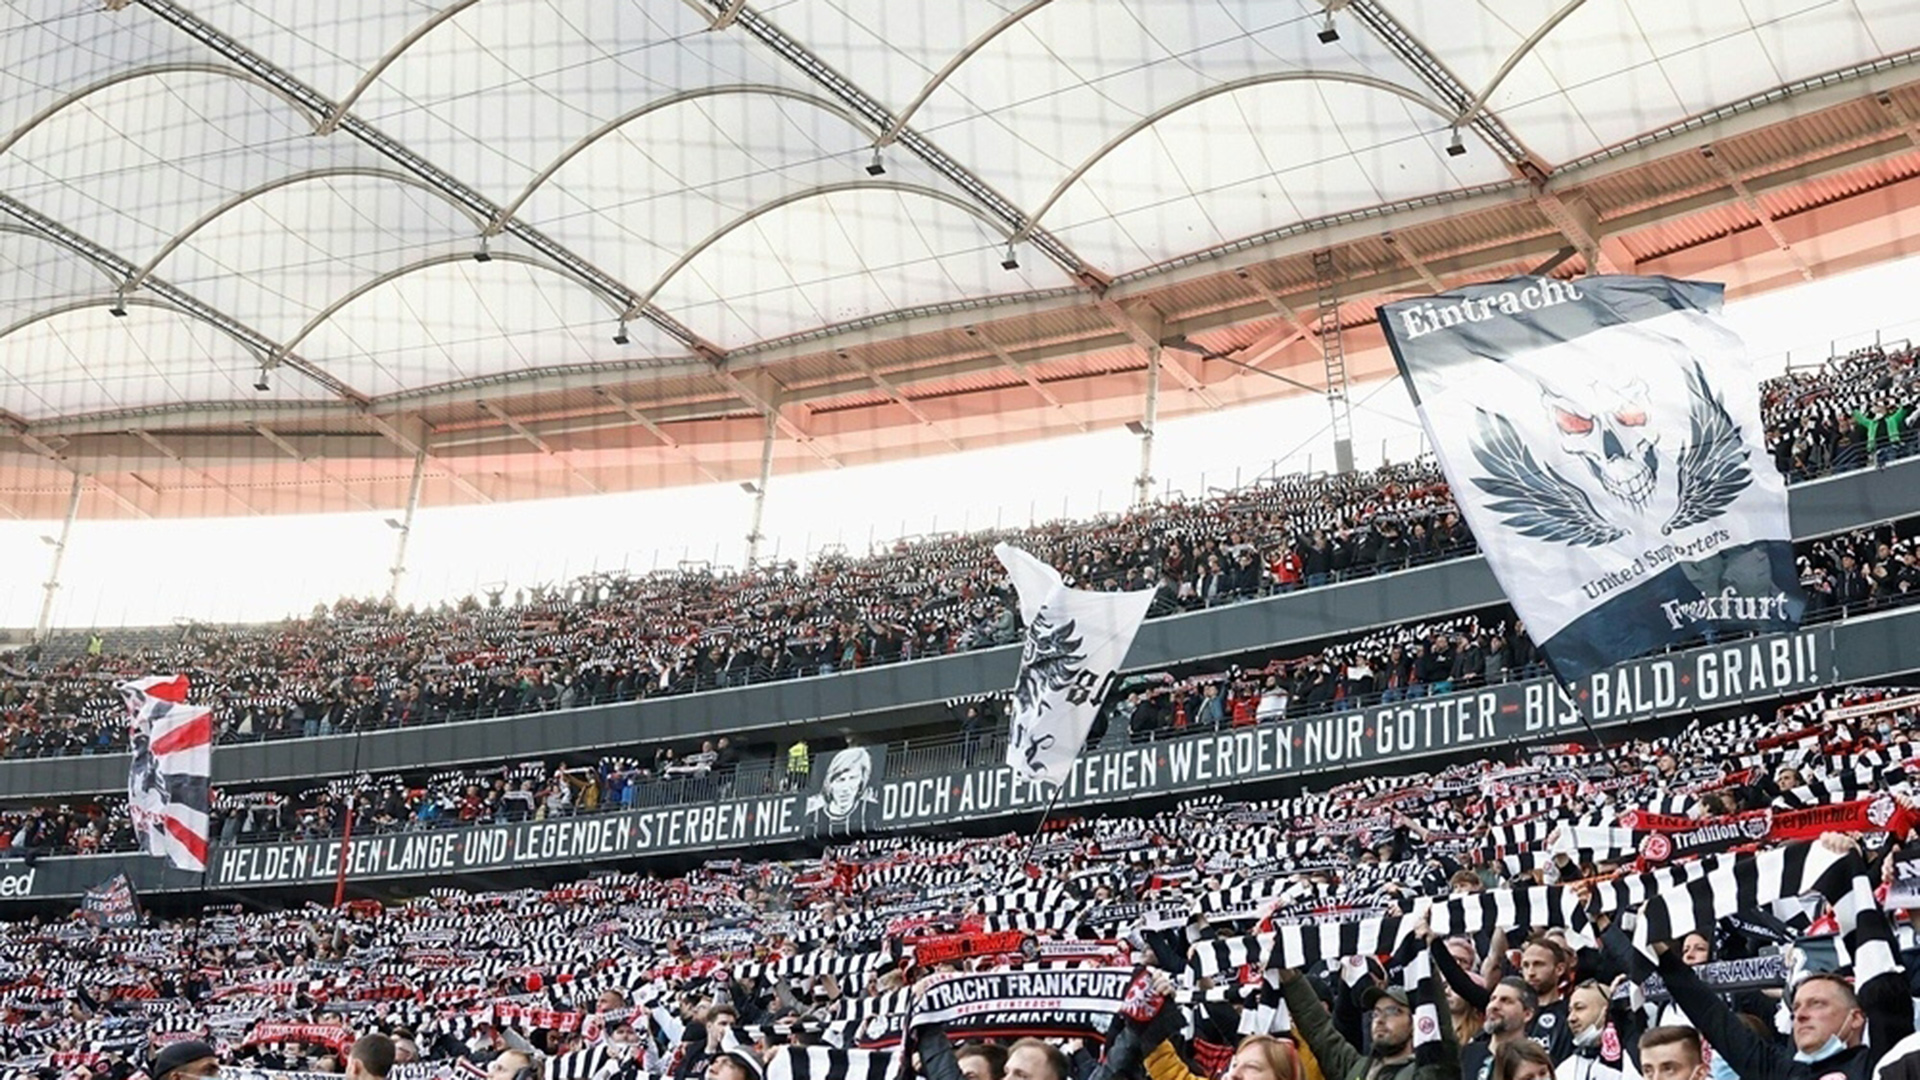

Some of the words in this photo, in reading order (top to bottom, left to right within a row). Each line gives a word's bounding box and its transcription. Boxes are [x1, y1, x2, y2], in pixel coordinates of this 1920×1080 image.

[1399, 277, 1584, 340] Eintracht
[1581, 558, 1645, 600] United
[882, 775, 950, 821] DOCH
[960, 745, 1158, 813] AUFERTEHEN
[1169, 726, 1293, 784] WERDEN
[1304, 715, 1364, 766] NUR
[1376, 693, 1497, 754] GÖTTER
[1525, 681, 1578, 731] BIS
[1591, 660, 1687, 719] BALD,
[1697, 634, 1819, 701] GRABI!
[220, 846, 309, 883] HELDEN
[387, 834, 458, 871] LANGE
[464, 829, 508, 865] UND
[514, 817, 632, 861] LEGENDEN
[637, 802, 748, 848] STERBEN
[754, 797, 800, 838] NIE.
[1672, 821, 1740, 851] Tradition
[1006, 972, 1130, 998] FRANKFURT
